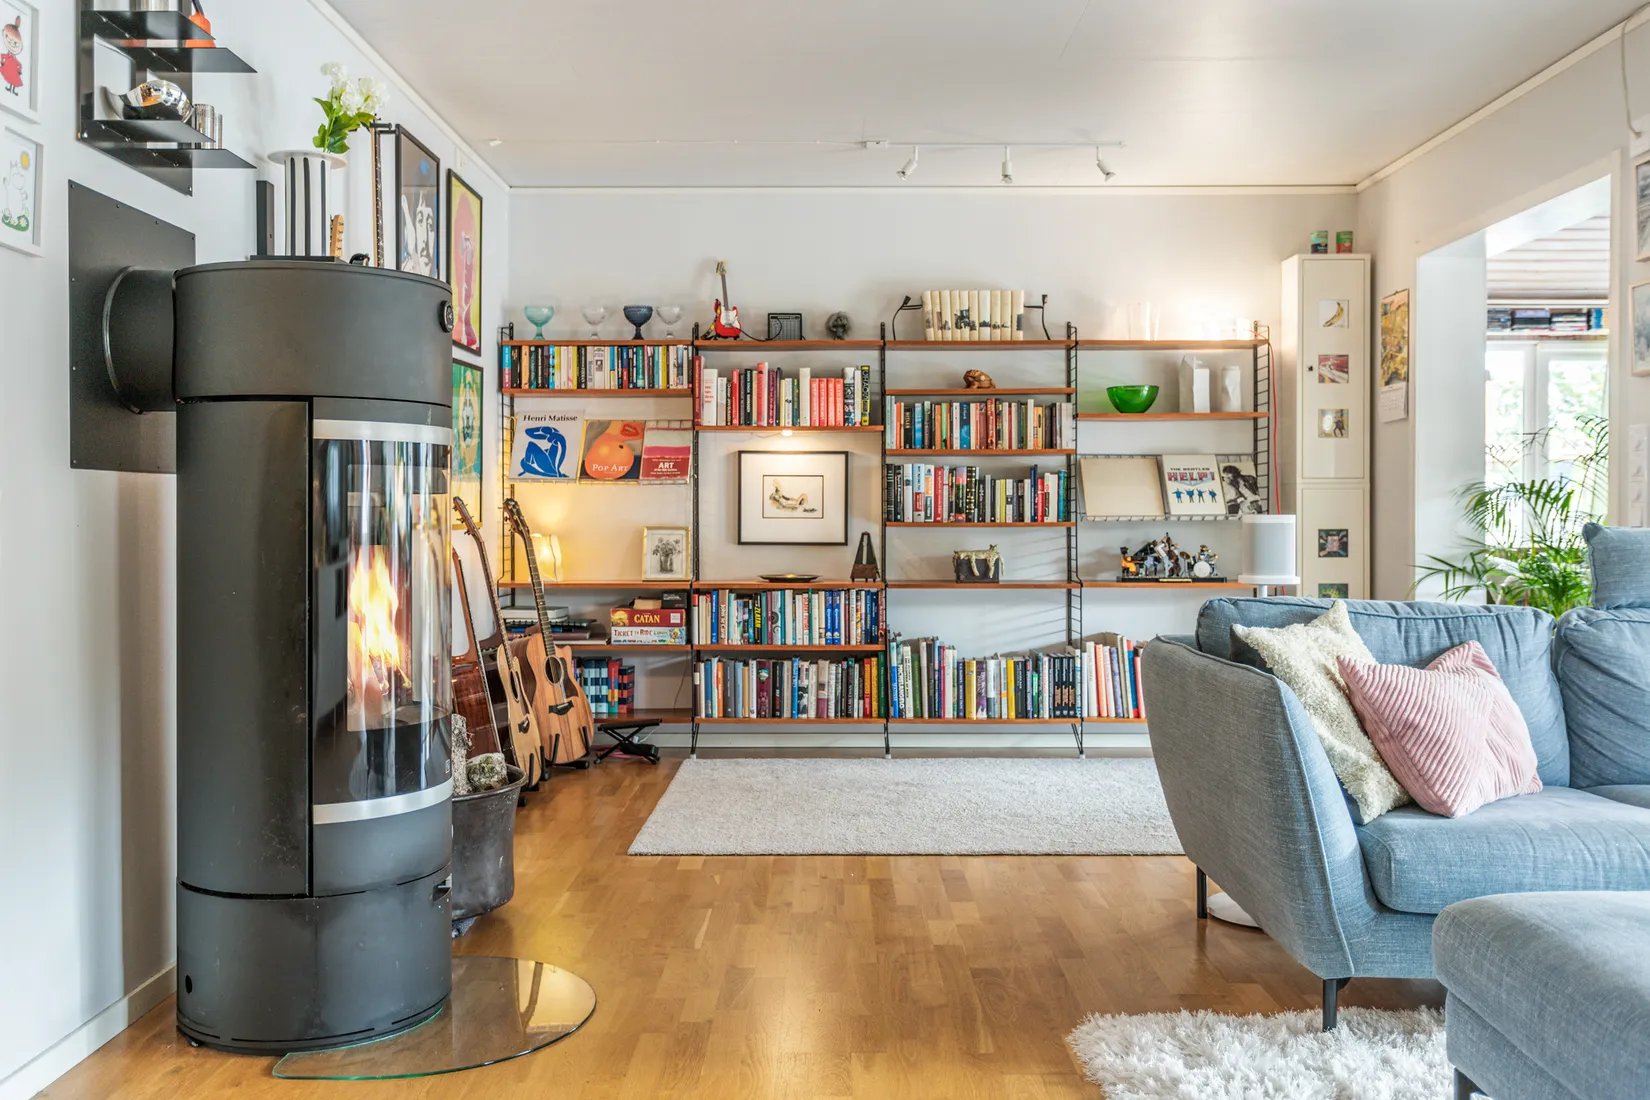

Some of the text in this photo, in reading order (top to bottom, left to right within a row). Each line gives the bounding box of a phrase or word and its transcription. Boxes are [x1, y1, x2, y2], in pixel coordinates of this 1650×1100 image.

[523, 414, 578, 422] Henri Matisse
[592, 463, 629, 472] POP ART
[1167, 471, 1215, 481] HELP!
[633, 614, 660, 624] CATAN
[754, 606, 762, 628] ZLATAN
[613, 629, 633, 637] TICKET
